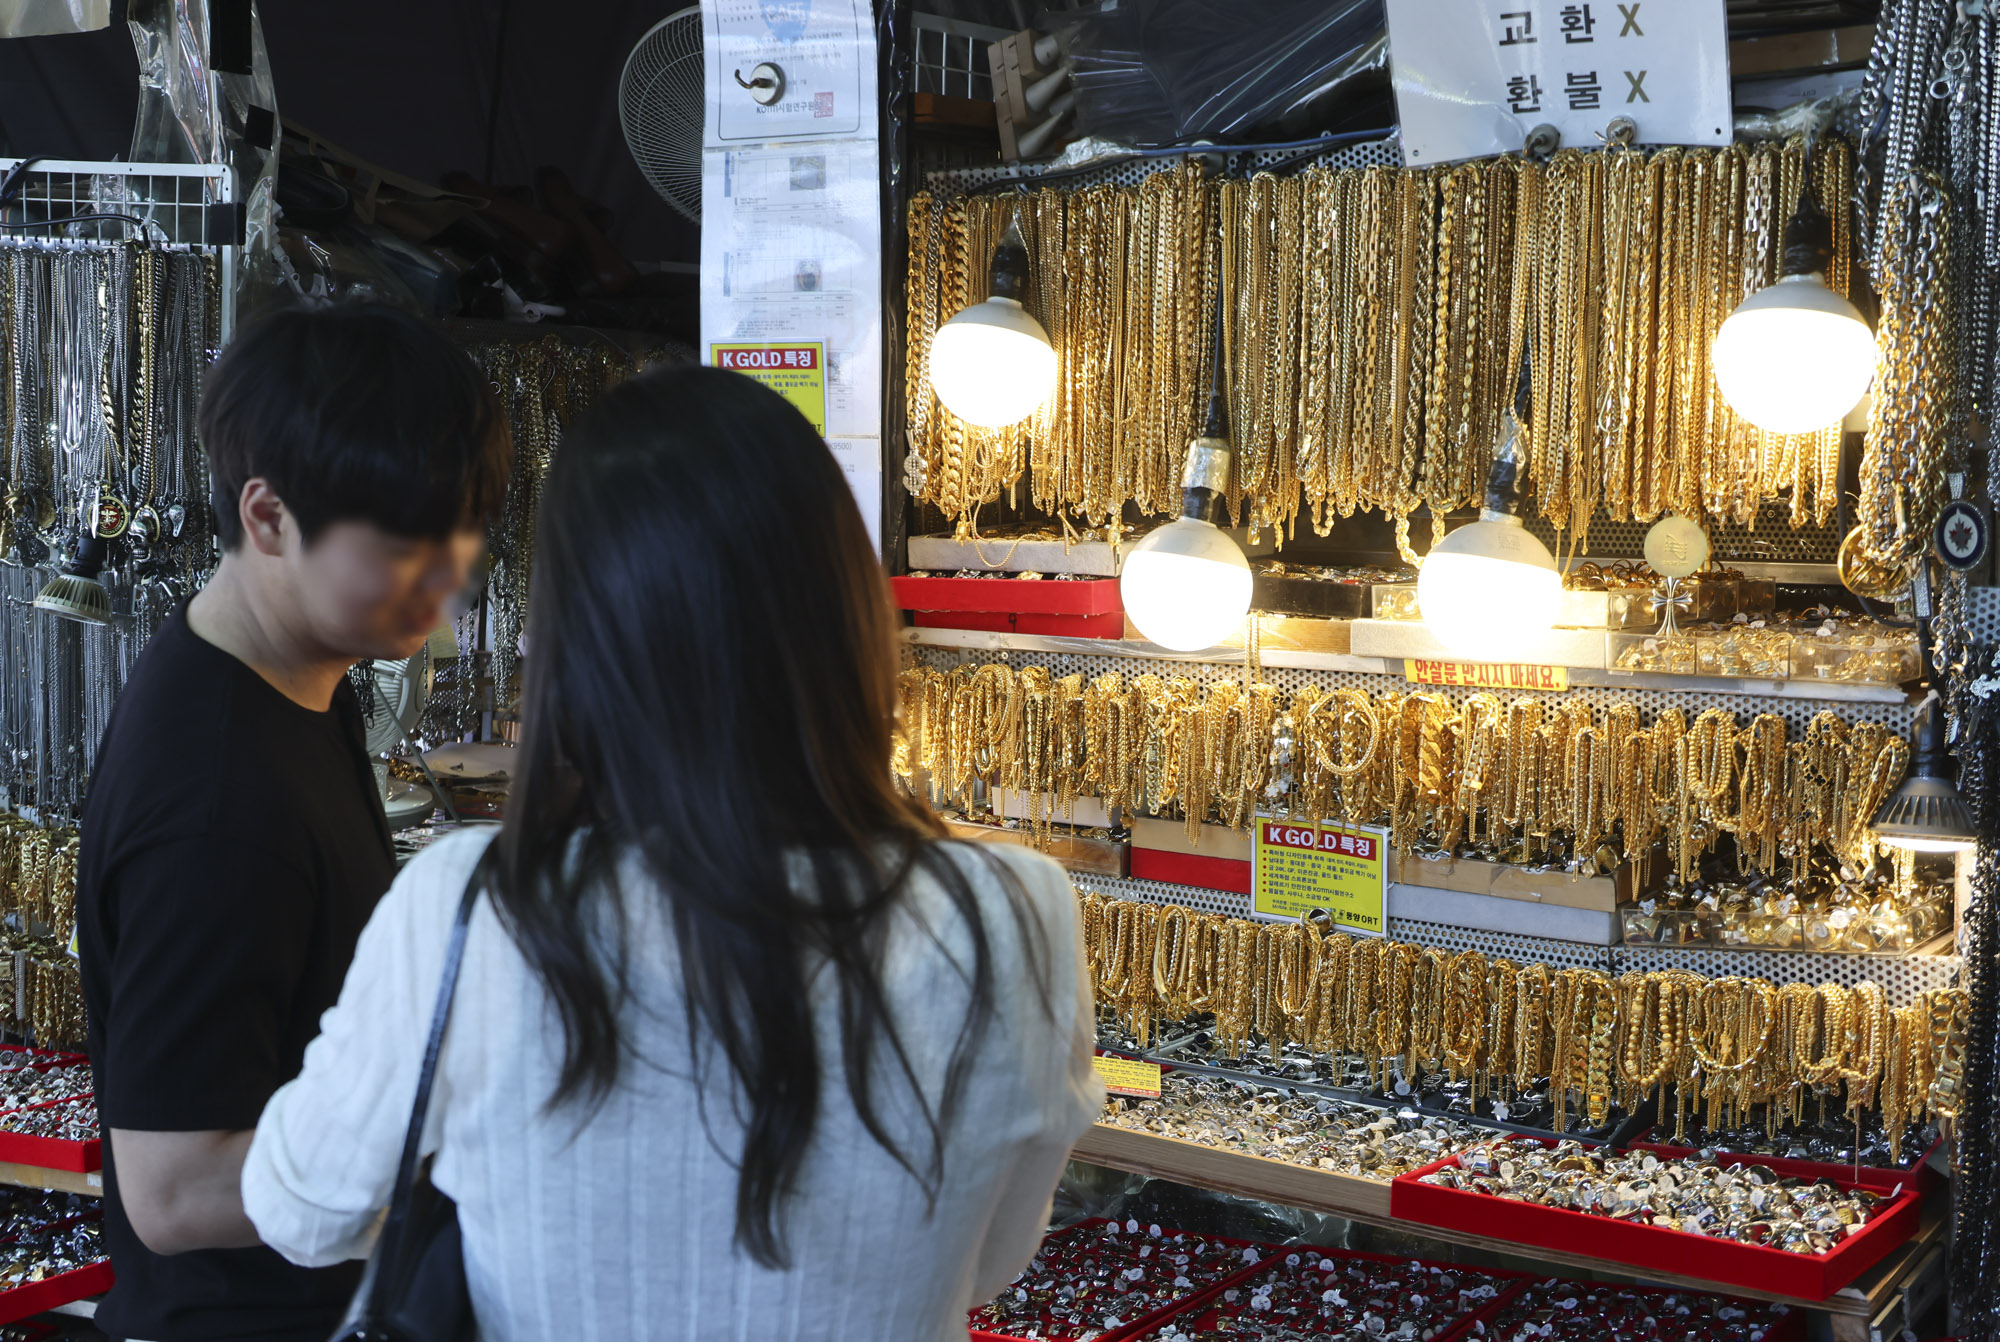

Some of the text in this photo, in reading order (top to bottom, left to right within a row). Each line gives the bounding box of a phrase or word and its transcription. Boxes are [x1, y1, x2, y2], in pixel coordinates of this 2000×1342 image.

[1617, 3, 1644, 37] X
[1623, 70, 1650, 104] X
[722, 350, 811, 367] K GOLD 특징
[1510, 664, 1560, 689] 마세요.
[1269, 827, 1282, 843] K
[1340, 836, 1370, 857] 특징
[1346, 911, 1379, 926] 동양 ORT
